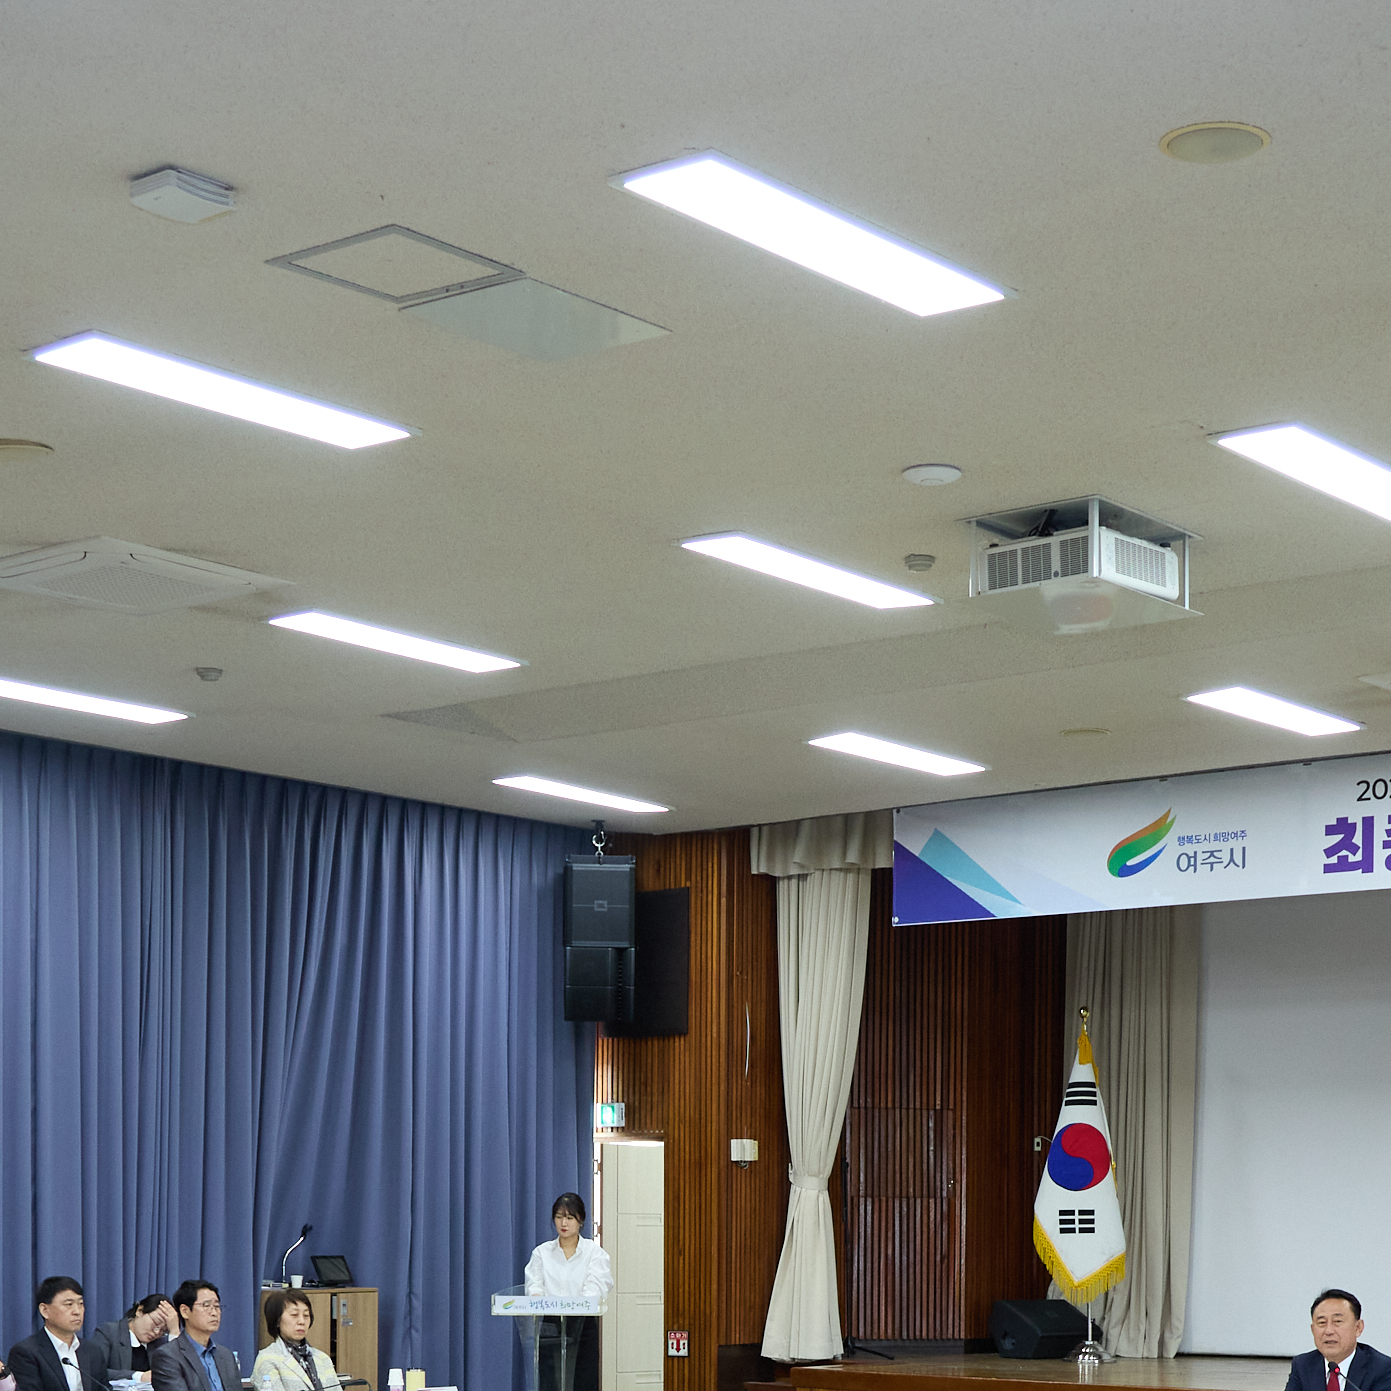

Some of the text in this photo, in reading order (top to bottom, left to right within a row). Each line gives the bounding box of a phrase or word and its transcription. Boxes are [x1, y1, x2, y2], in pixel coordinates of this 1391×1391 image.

[1177, 830, 1247, 846] 행복도시 희망여주
[1176, 846, 1246, 873] 여주시
